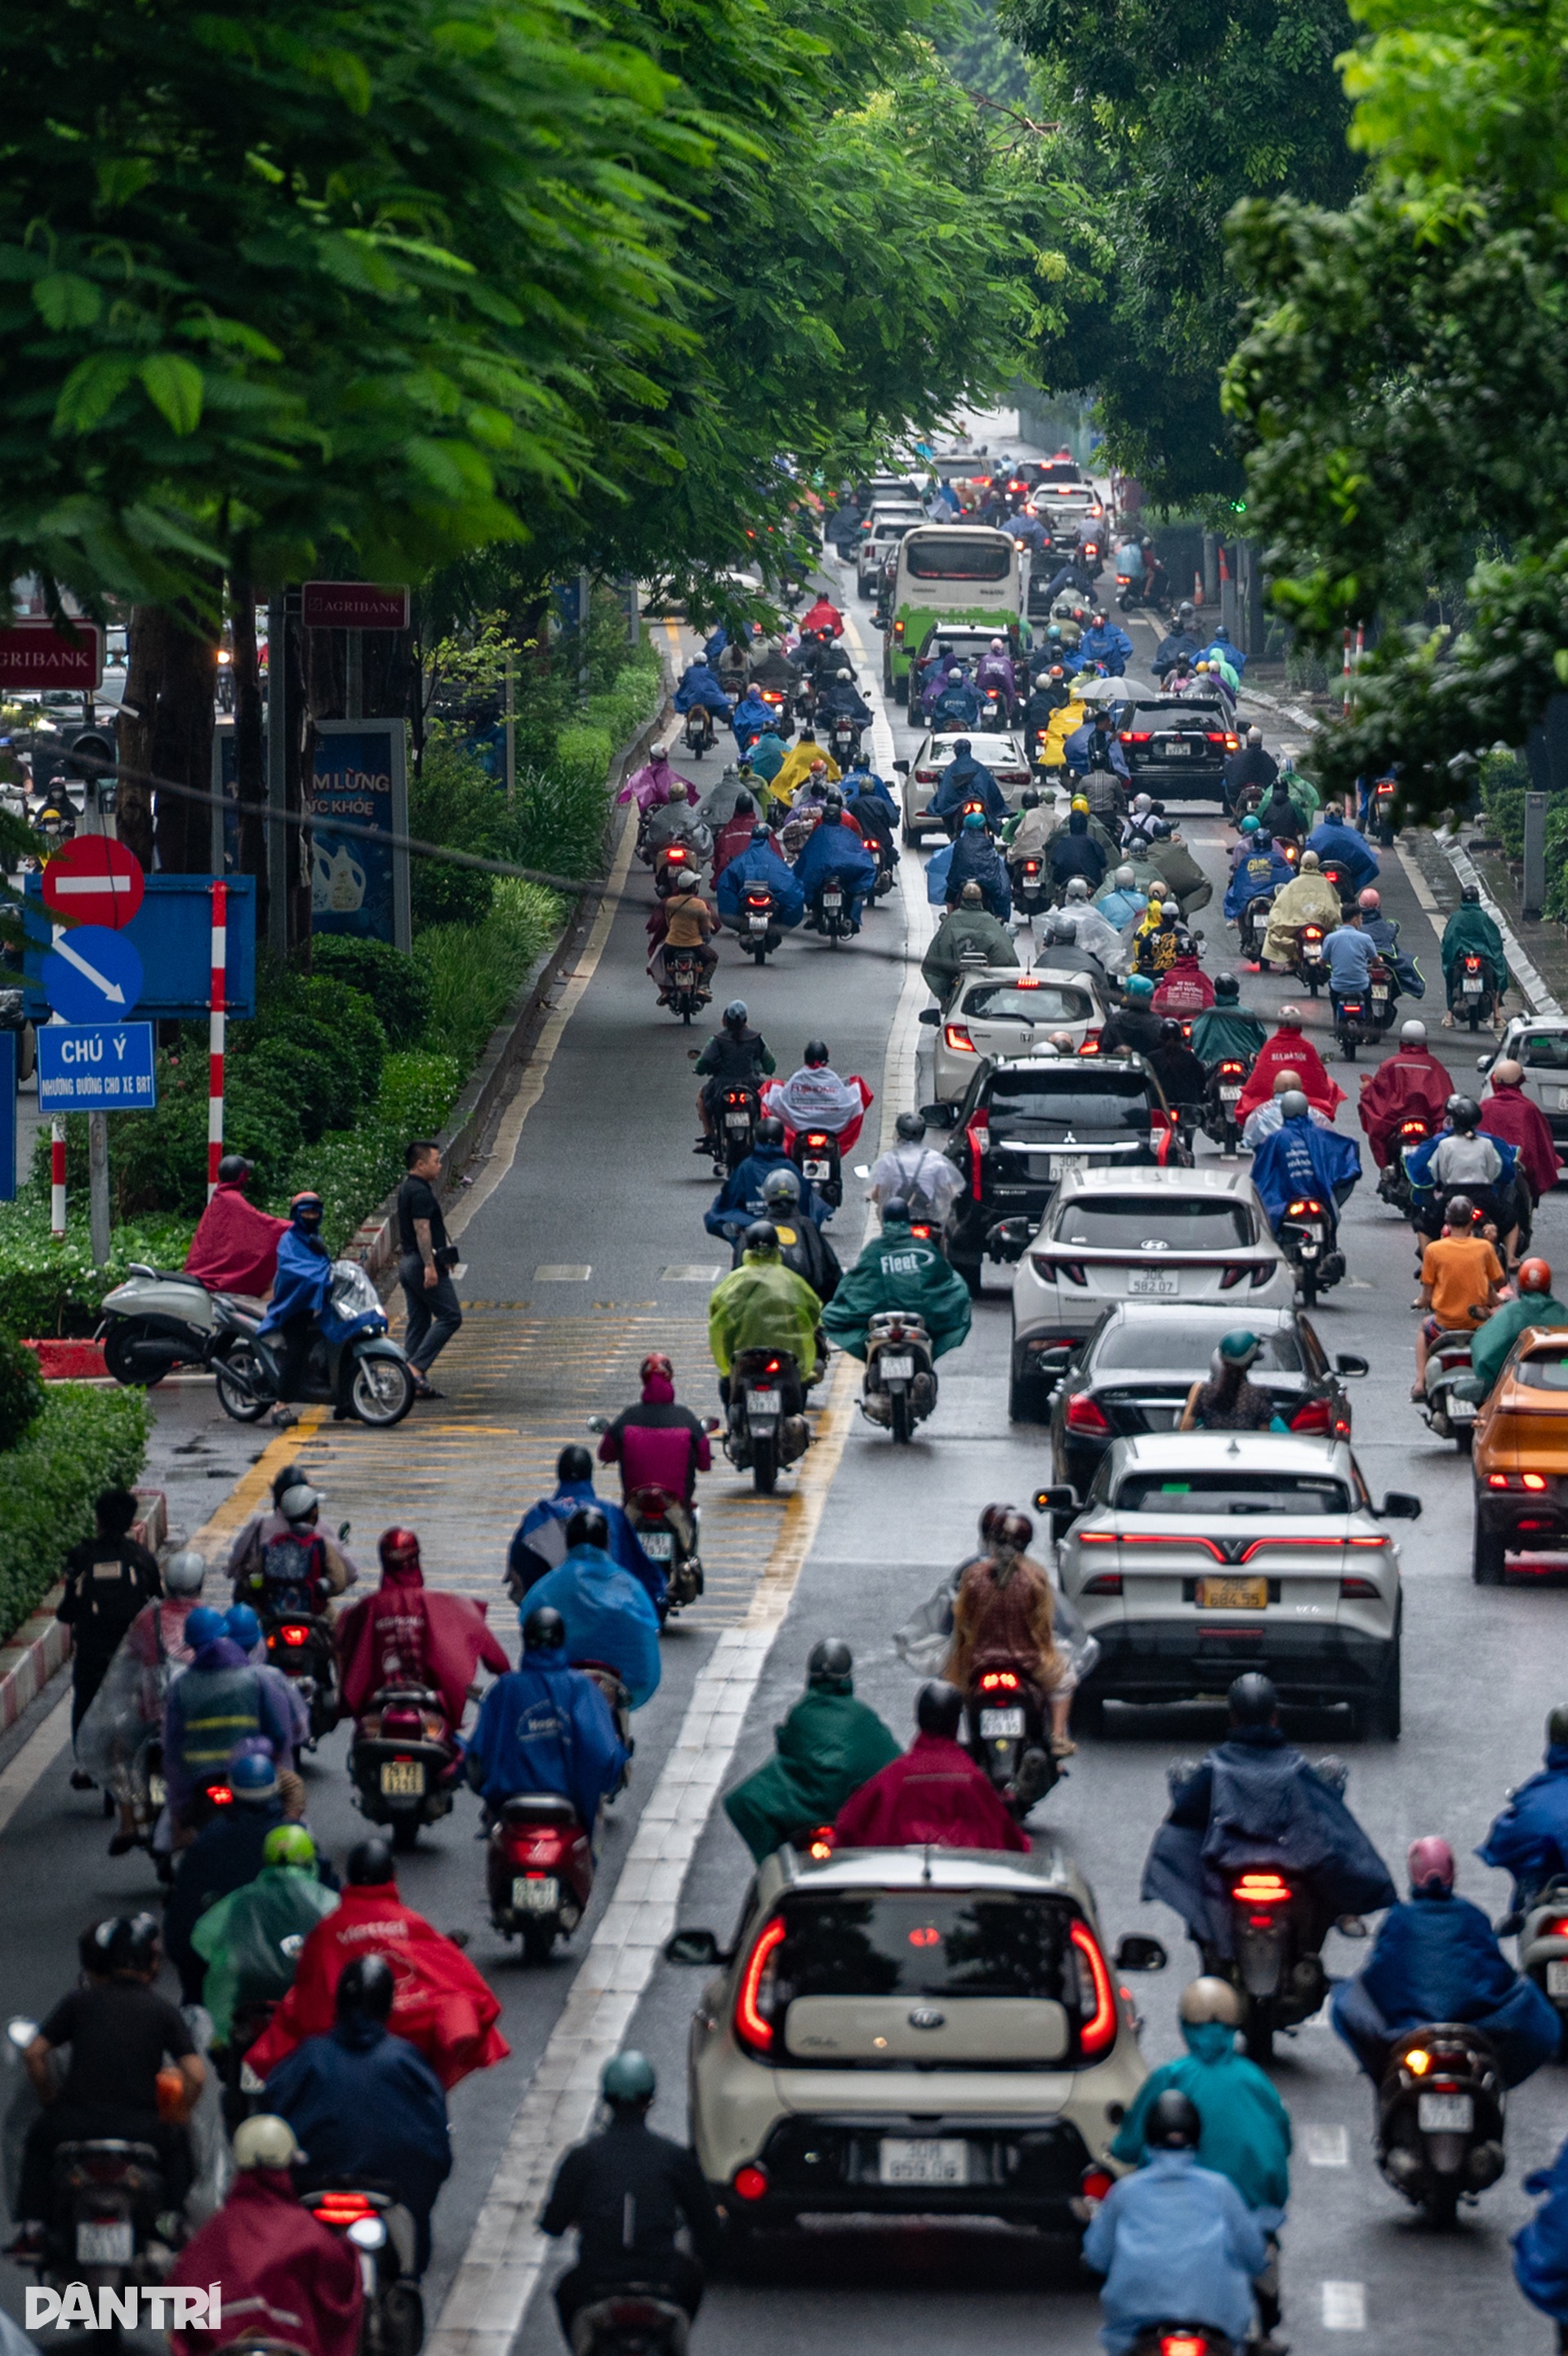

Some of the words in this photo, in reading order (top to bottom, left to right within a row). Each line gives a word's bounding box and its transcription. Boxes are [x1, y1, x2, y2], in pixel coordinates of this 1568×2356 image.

[325, 601, 399, 613] AGRIBANK
[333, 767, 390, 792] LỪNG
[61, 1033, 103, 1063] CHÚ
[113, 1032, 127, 1061] Ý
[104, 1076, 120, 1094] CHO
[122, 1076, 134, 1093] XE
[136, 1075, 151, 1093] BRT
[880, 1253, 919, 1275] Fleet
[1133, 1280, 1174, 1292] 582.07
